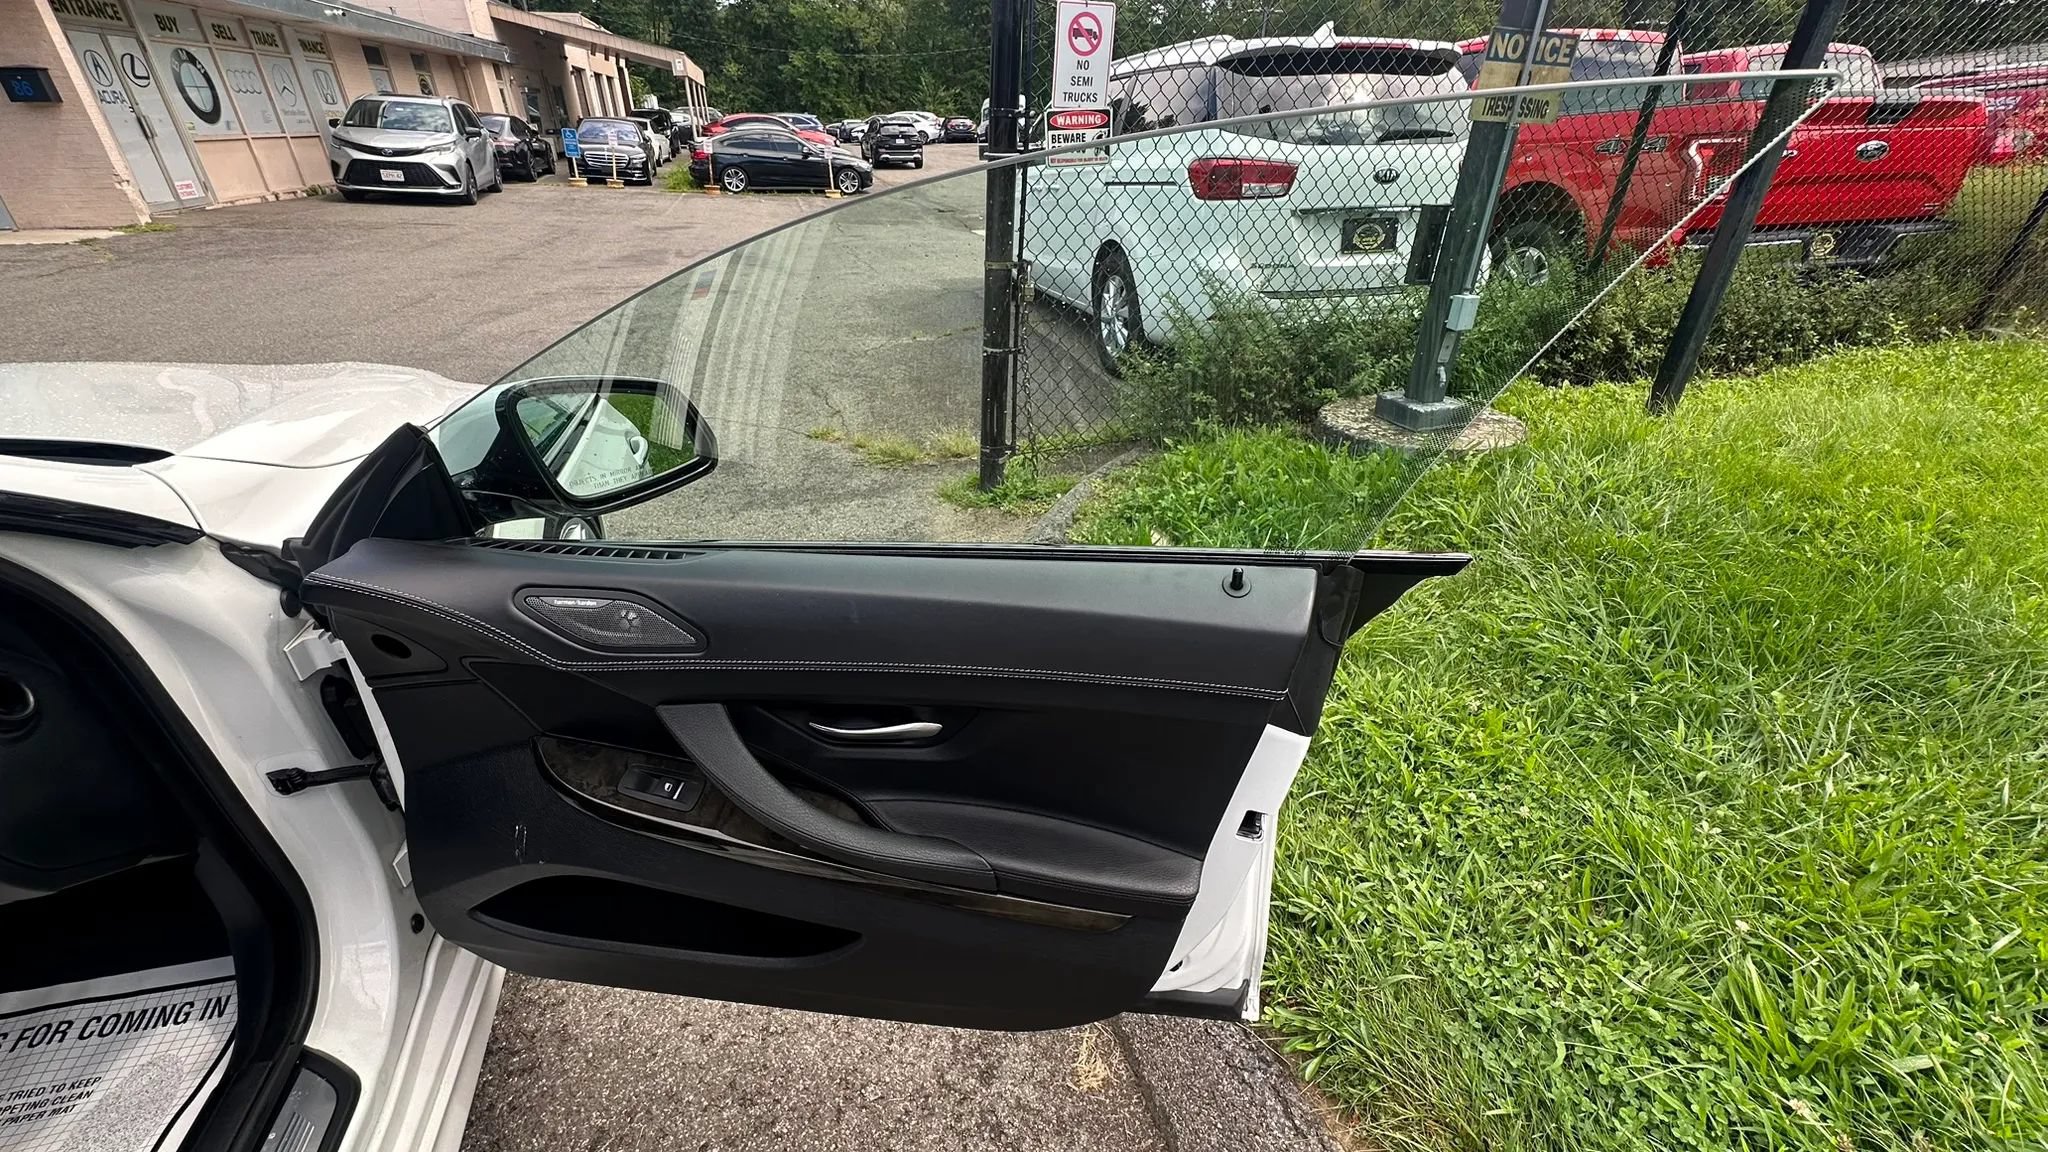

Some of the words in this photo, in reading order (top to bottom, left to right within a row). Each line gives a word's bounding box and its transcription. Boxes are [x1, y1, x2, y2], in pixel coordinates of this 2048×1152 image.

[51, 0, 123, 21] ENTRANCE
[153, 13, 180, 33] BUY
[211, 22, 237, 41] SELL
[250, 29, 279, 48] TRADE
[1490, 33, 1576, 64] NOICE
[1076, 60, 1090, 71] NO
[1070, 76, 1093, 87] SEMI
[1063, 92, 1098, 103] TRUCKS
[1481, 95, 1550, 119] TRESPSSING
[1056, 114, 1102, 126] WARNING
[1051, 132, 1087, 144] BEWARE
[9, 1020, 75, 1053] FOR
[78, 1001, 195, 1041] COMING
[199, 995, 232, 1021] IN
[7, 1087, 46, 1102] TRIED
[50, 1083, 67, 1094] TO
[68, 1076, 102, 1091] KEEP
[0, 1098, 50, 1116] PETING
[51, 1089, 94, 1106] CLEAN
[1, 1110, 47, 1126] PAPER
[48, 1104, 79, 1117] MAT
